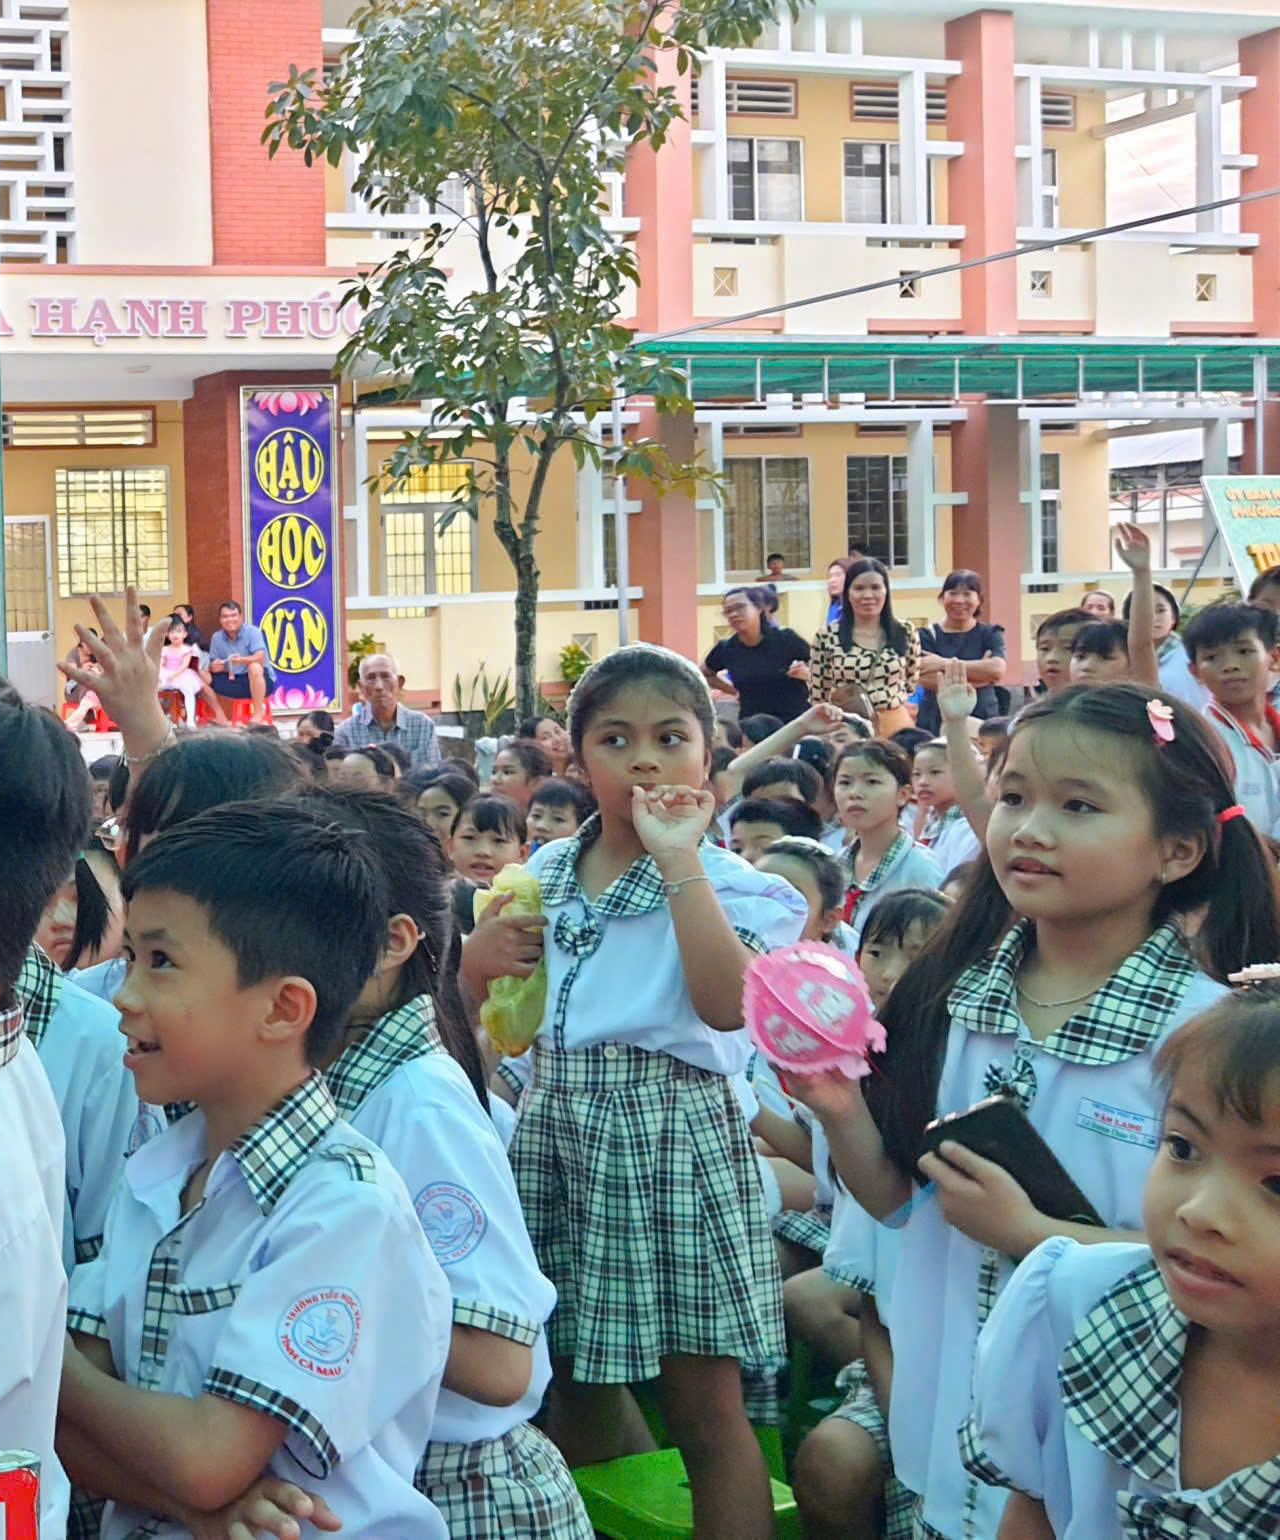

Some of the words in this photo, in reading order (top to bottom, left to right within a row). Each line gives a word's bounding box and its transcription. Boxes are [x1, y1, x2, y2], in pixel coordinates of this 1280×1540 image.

[30, 297, 208, 346] HẠNH
[258, 431, 321, 500] HẬU
[260, 515, 324, 586] HỌC
[261, 608, 324, 670] VĂN
